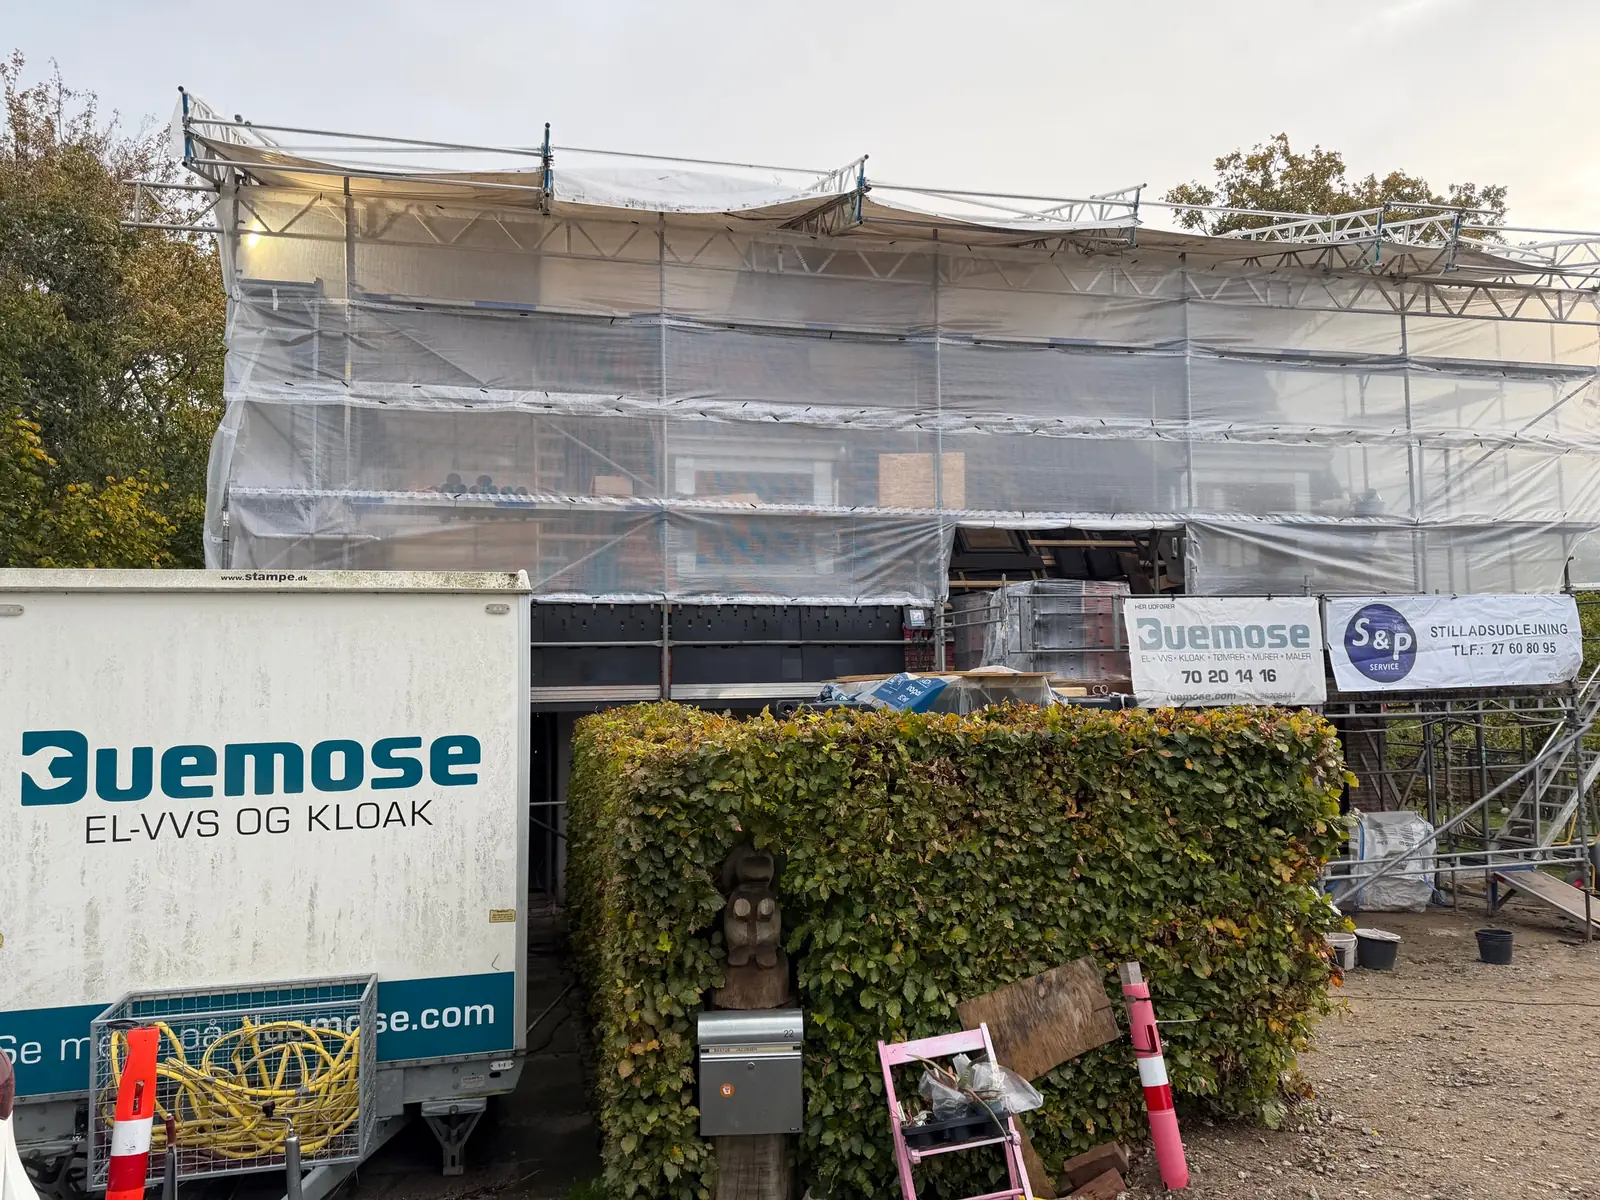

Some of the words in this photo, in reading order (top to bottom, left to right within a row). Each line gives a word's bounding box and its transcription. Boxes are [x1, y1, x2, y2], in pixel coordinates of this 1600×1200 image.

[221, 572, 308, 582] www.stampe.dk
[1430, 623, 1568, 638] STILLADSUDLEJNING
[1452, 644, 1484, 656] TLF.:
[1491, 643, 1504, 655] 27
[1509, 642, 1522, 654] 60
[1526, 642, 1539, 654] 80
[1543, 642, 1556, 653] 95
[1158, 654, 1173, 662] VVS
[1179, 654, 1205, 662] KLOAK
[1213, 653, 1245, 661] TØMRER
[1252, 653, 1279, 661] MURER
[1285, 652, 1311, 660] MALER
[1369, 663, 1400, 671] SERVICE
[1181, 670, 1203, 684] 70
[1208, 669, 1229, 683] 20
[1235, 669, 1253, 683] 14
[1259, 668, 1277, 682] 16
[85, 810, 220, 844] EL-VVS
[236, 806, 290, 835] OG
[307, 799, 434, 832] KLOAK
[783, 1029, 794, 1038] 22
[0, 1035, 42, 1065] Se
